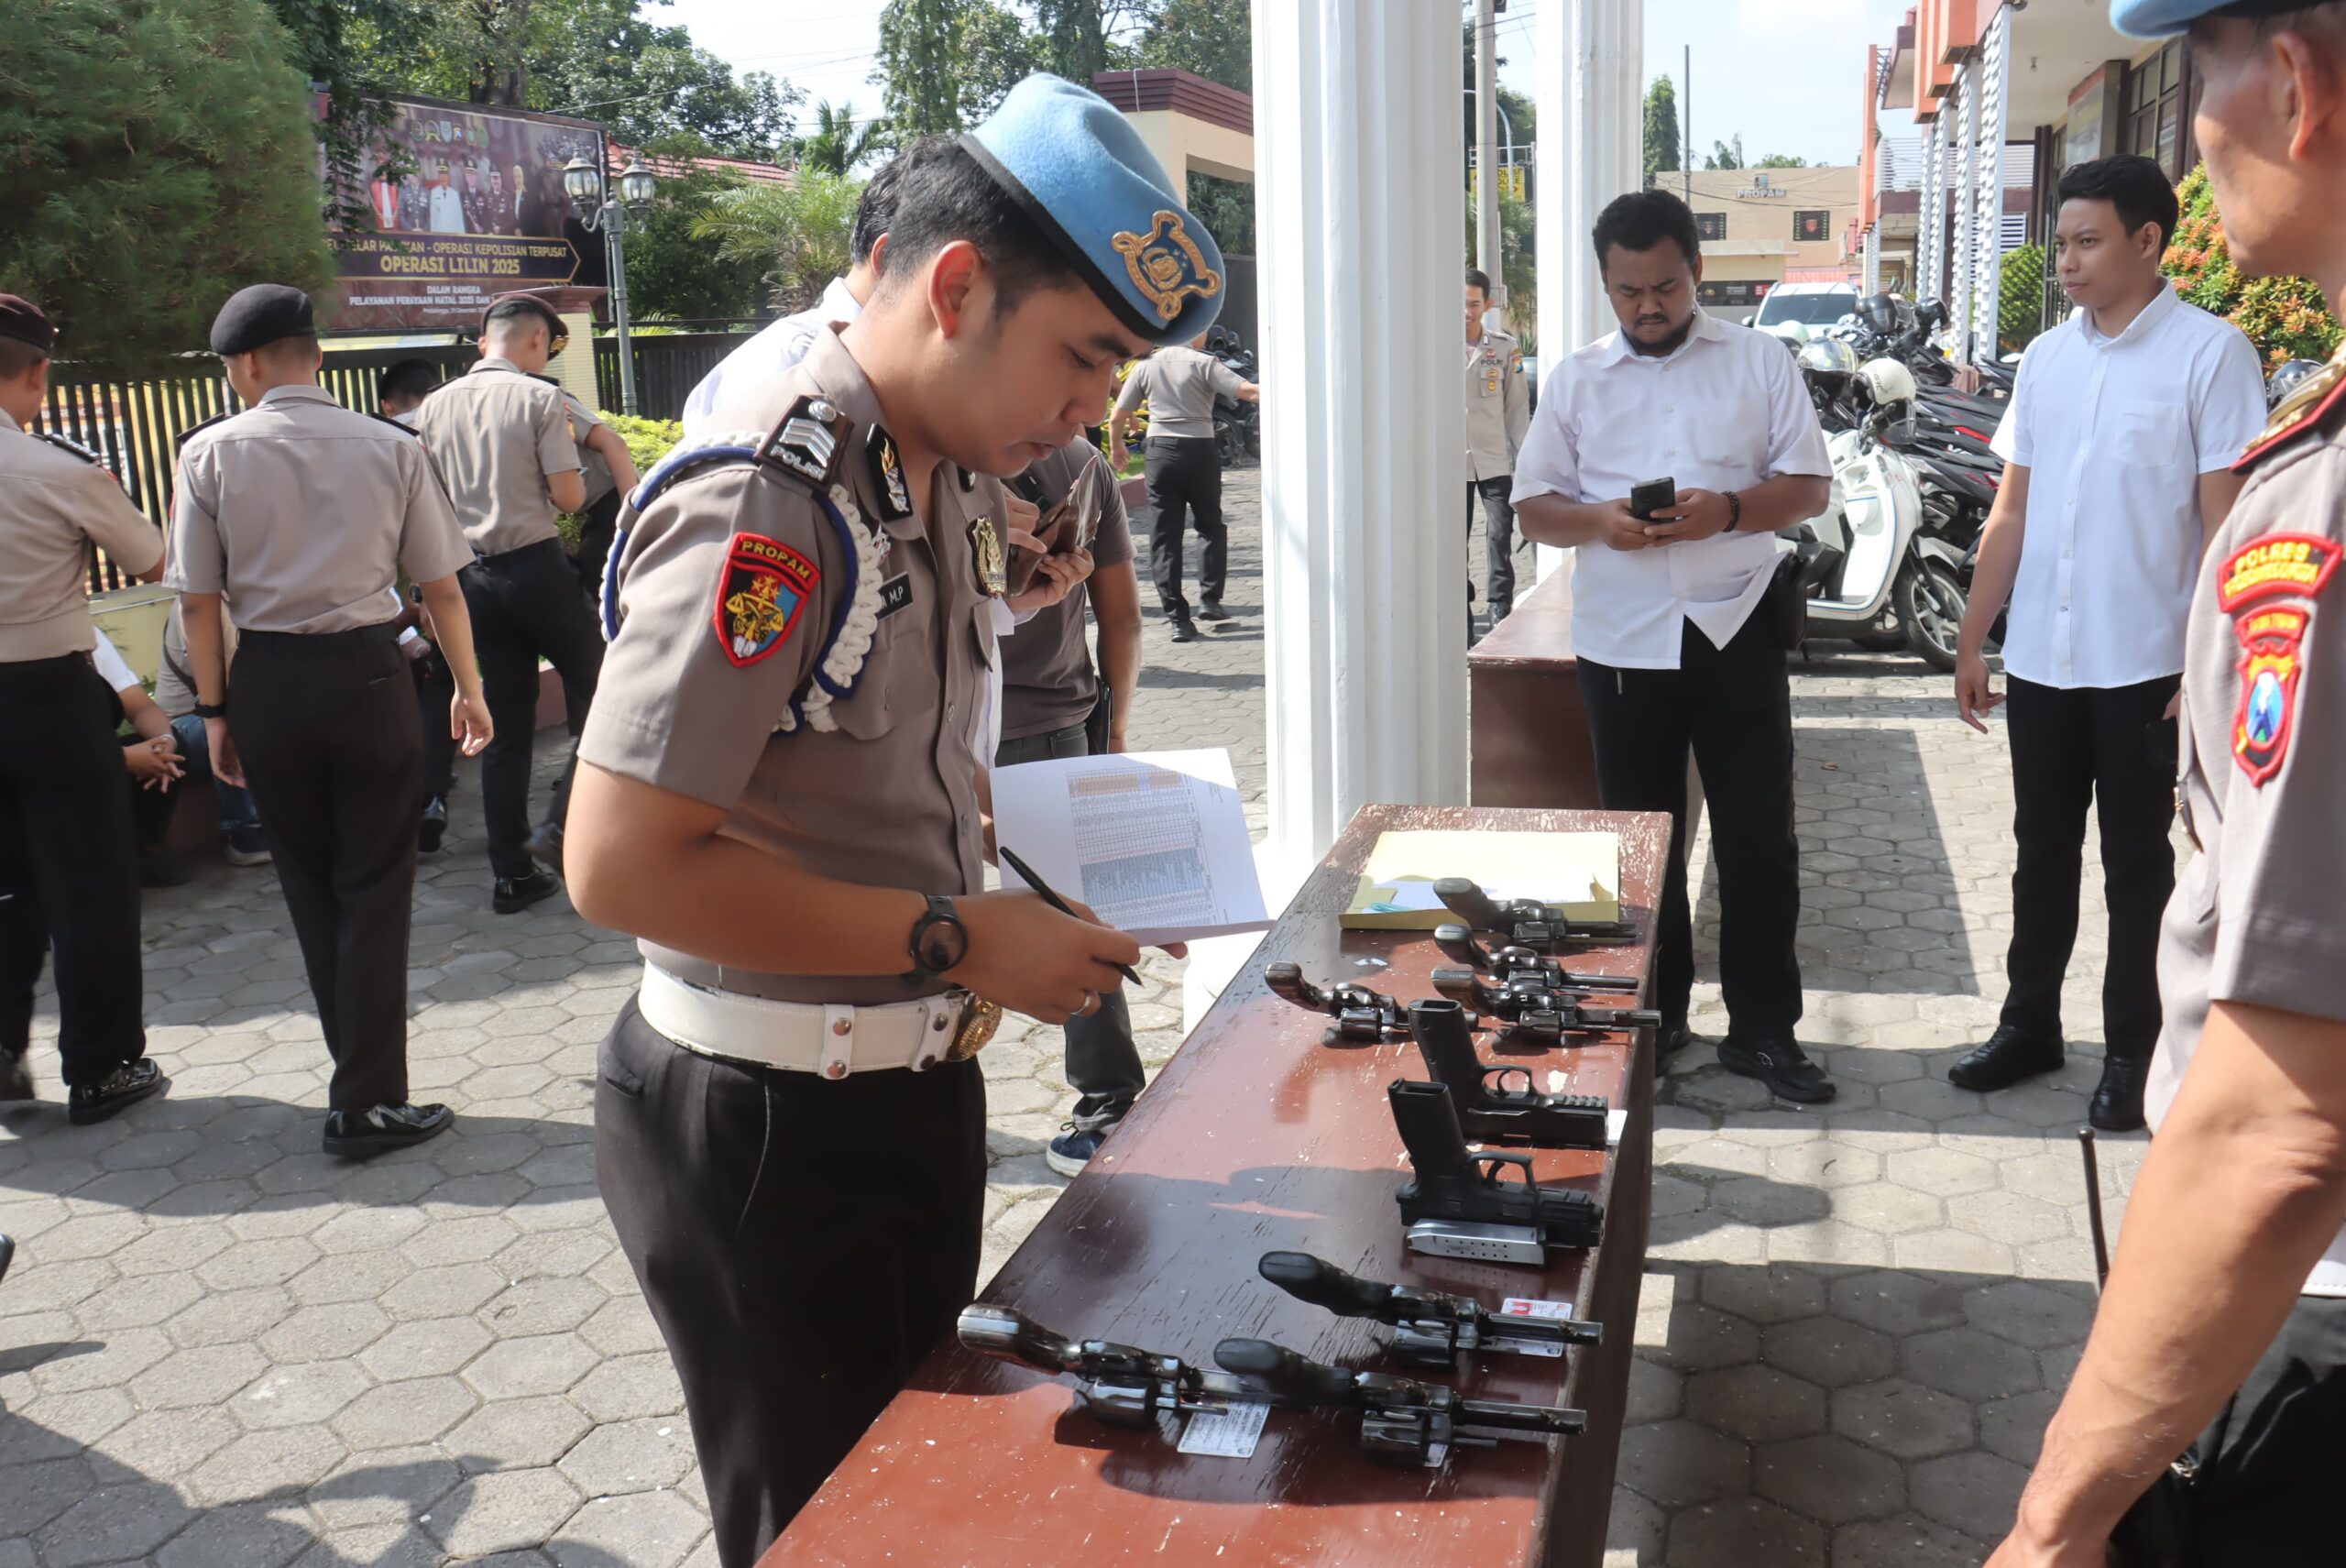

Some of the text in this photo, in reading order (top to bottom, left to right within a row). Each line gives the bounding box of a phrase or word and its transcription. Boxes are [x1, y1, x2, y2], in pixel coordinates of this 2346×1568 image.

[1736, 189, 1786, 199] PROPAM
[346, 238, 377, 252] ELAR
[379, 240, 424, 253] PAAN
[433, 242, 473, 255] OPERASI
[475, 243, 528, 257] KEPOLISIAN
[528, 246, 567, 258] TERPUSAT
[380, 255, 521, 274] OPERASI LILIN 2025
[426, 285, 451, 294] DALAM
[349, 296, 394, 306] PELAYANAN
[434, 295, 457, 304] NATAL
[770, 444, 826, 482] POLISI
[741, 541, 810, 579] PROPAM
[2234, 541, 2311, 576] POLRES
